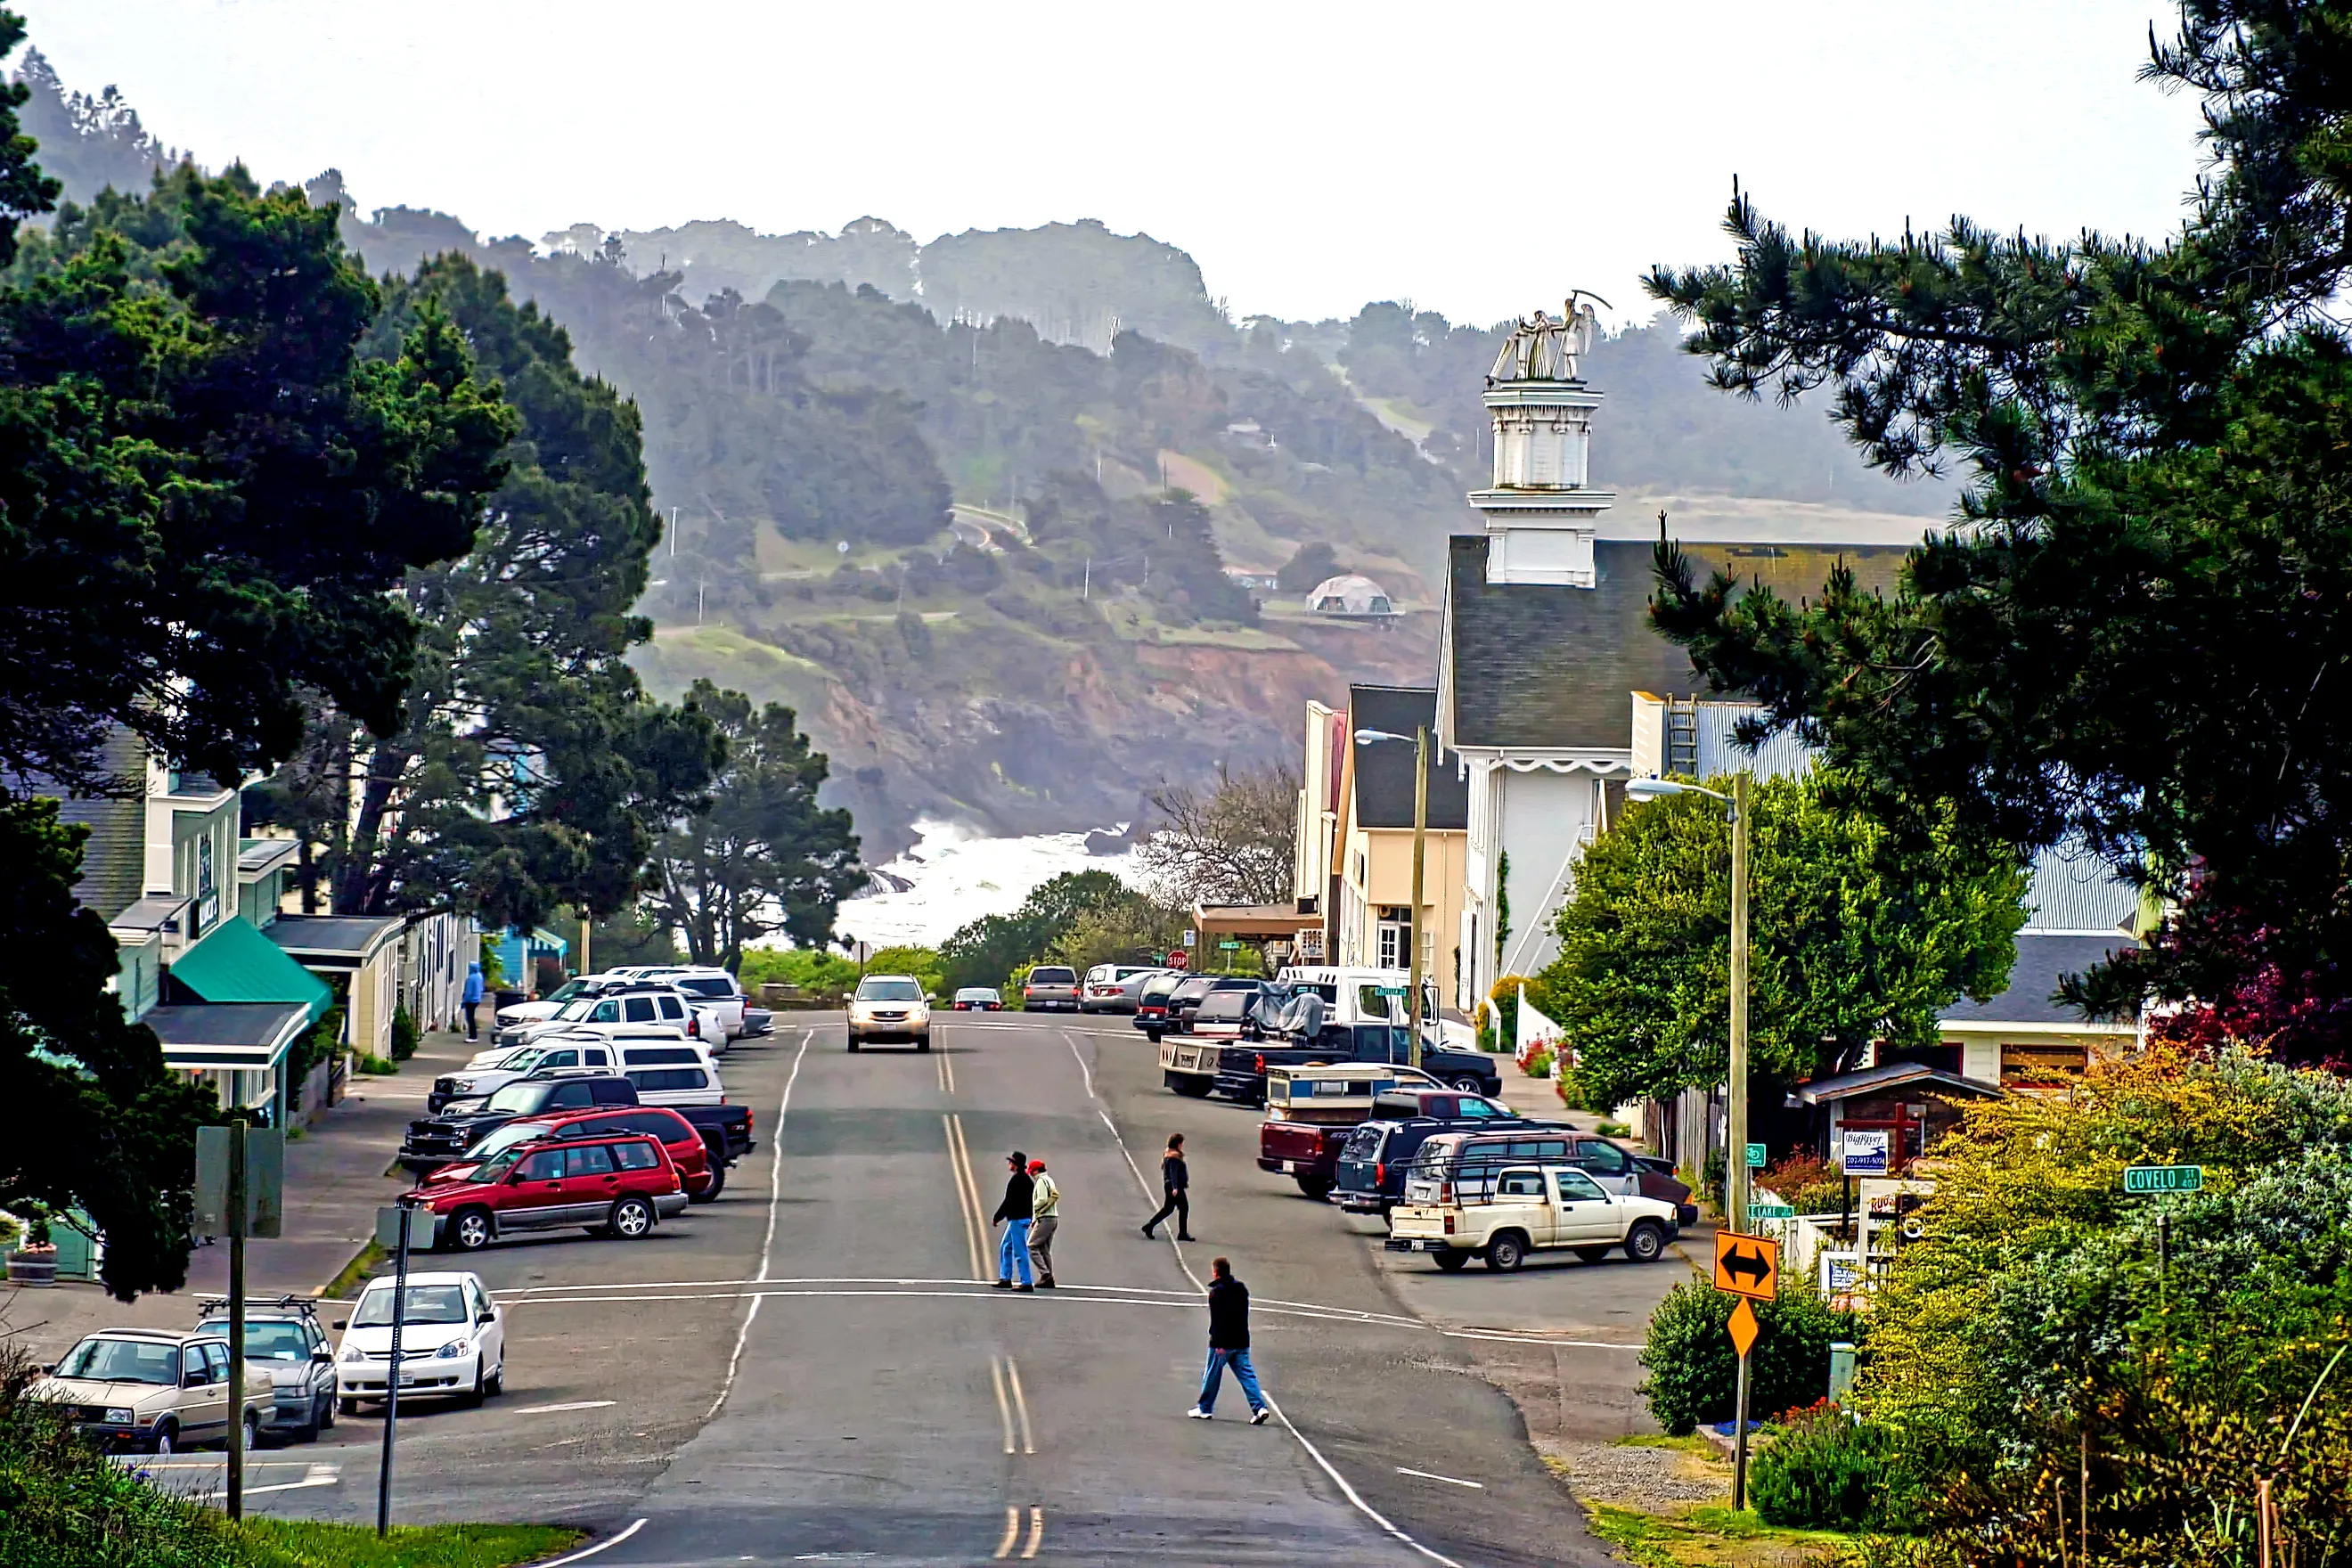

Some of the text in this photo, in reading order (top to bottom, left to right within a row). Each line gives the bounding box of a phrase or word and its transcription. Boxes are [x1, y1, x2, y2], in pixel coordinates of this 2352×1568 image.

[1168, 956, 1187, 966] STOP
[2128, 1170, 2176, 1189] COVELO
[1758, 1205, 1776, 1217] LAKE
